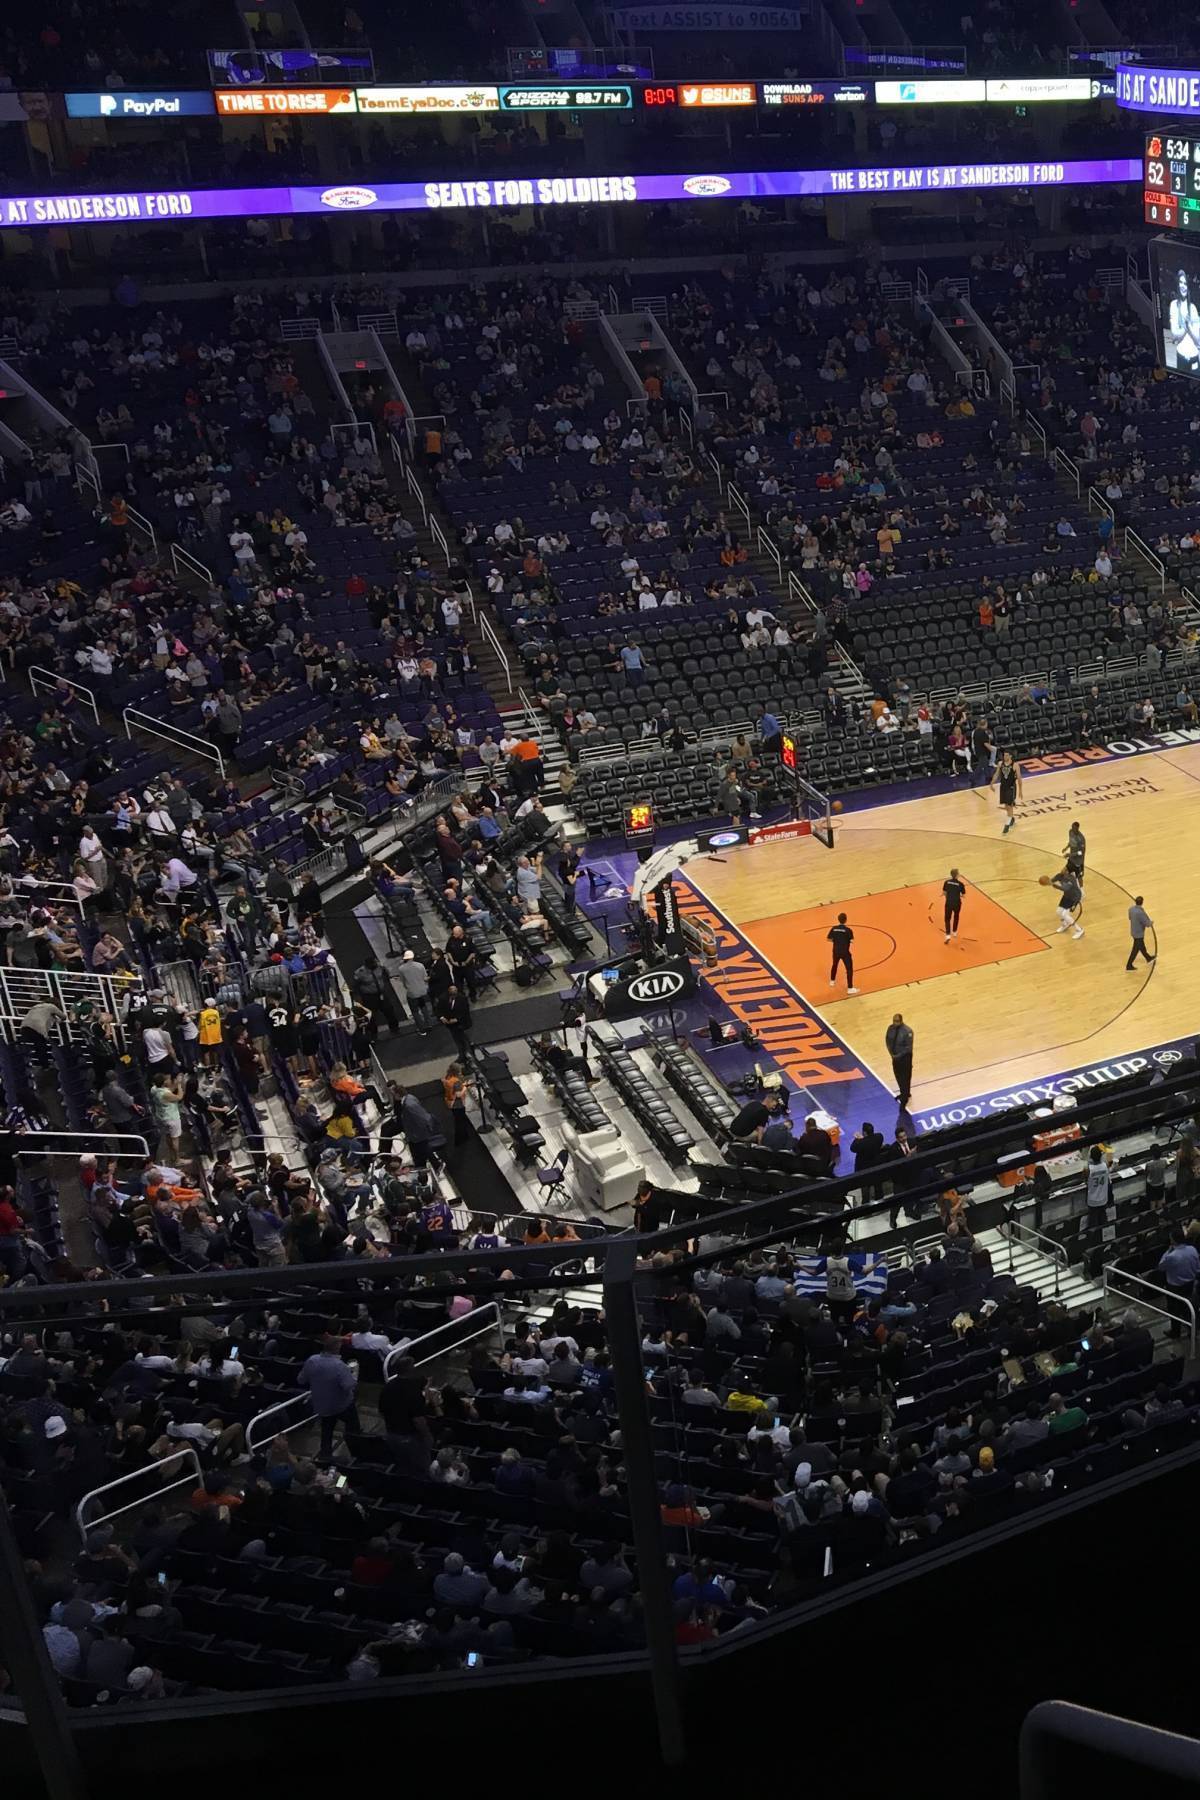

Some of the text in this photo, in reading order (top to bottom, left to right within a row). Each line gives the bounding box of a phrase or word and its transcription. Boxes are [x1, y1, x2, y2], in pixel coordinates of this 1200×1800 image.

[662, 11, 722, 27] ASSIST
[507, 91, 570, 99] ARIZONA
[645, 89, 675, 104] 8:09
[700, 87, 751, 101] @SUNS
[763, 84, 812, 94] DOWNLOAD
[219, 93, 327, 111] TIME TO RISE
[510, 98, 568, 106] SPORTS
[603, 92, 621, 104] FM
[764, 94, 825, 104] THE SUNS APP
[123, 98, 179, 115] PayPal
[1166, 139, 1189, 160] 5:34
[830, 164, 1064, 191] THE BEST PLAY IS AT SANDERSON FORD
[1148, 161, 1164, 185] 52
[1175, 176, 1181, 190] 3
[424, 176, 637, 208] SEATS FOR SOLDIERS
[8, 203, 29, 222] AT
[35, 196, 140, 220] SANDERSON
[146, 194, 192, 216] FORD
[1151, 205, 1171, 222] 0 5
[1183, 211, 1189, 225] 5
[1106, 738, 1162, 754] TO
[1023, 746, 1112, 773] RISE
[666, 889, 675, 935] Southwest
[637, 974, 674, 999] KIA
[272, 1016, 288, 1027] 34
[427, 1215, 444, 1232] 22
[831, 1275, 846, 1287] 34
